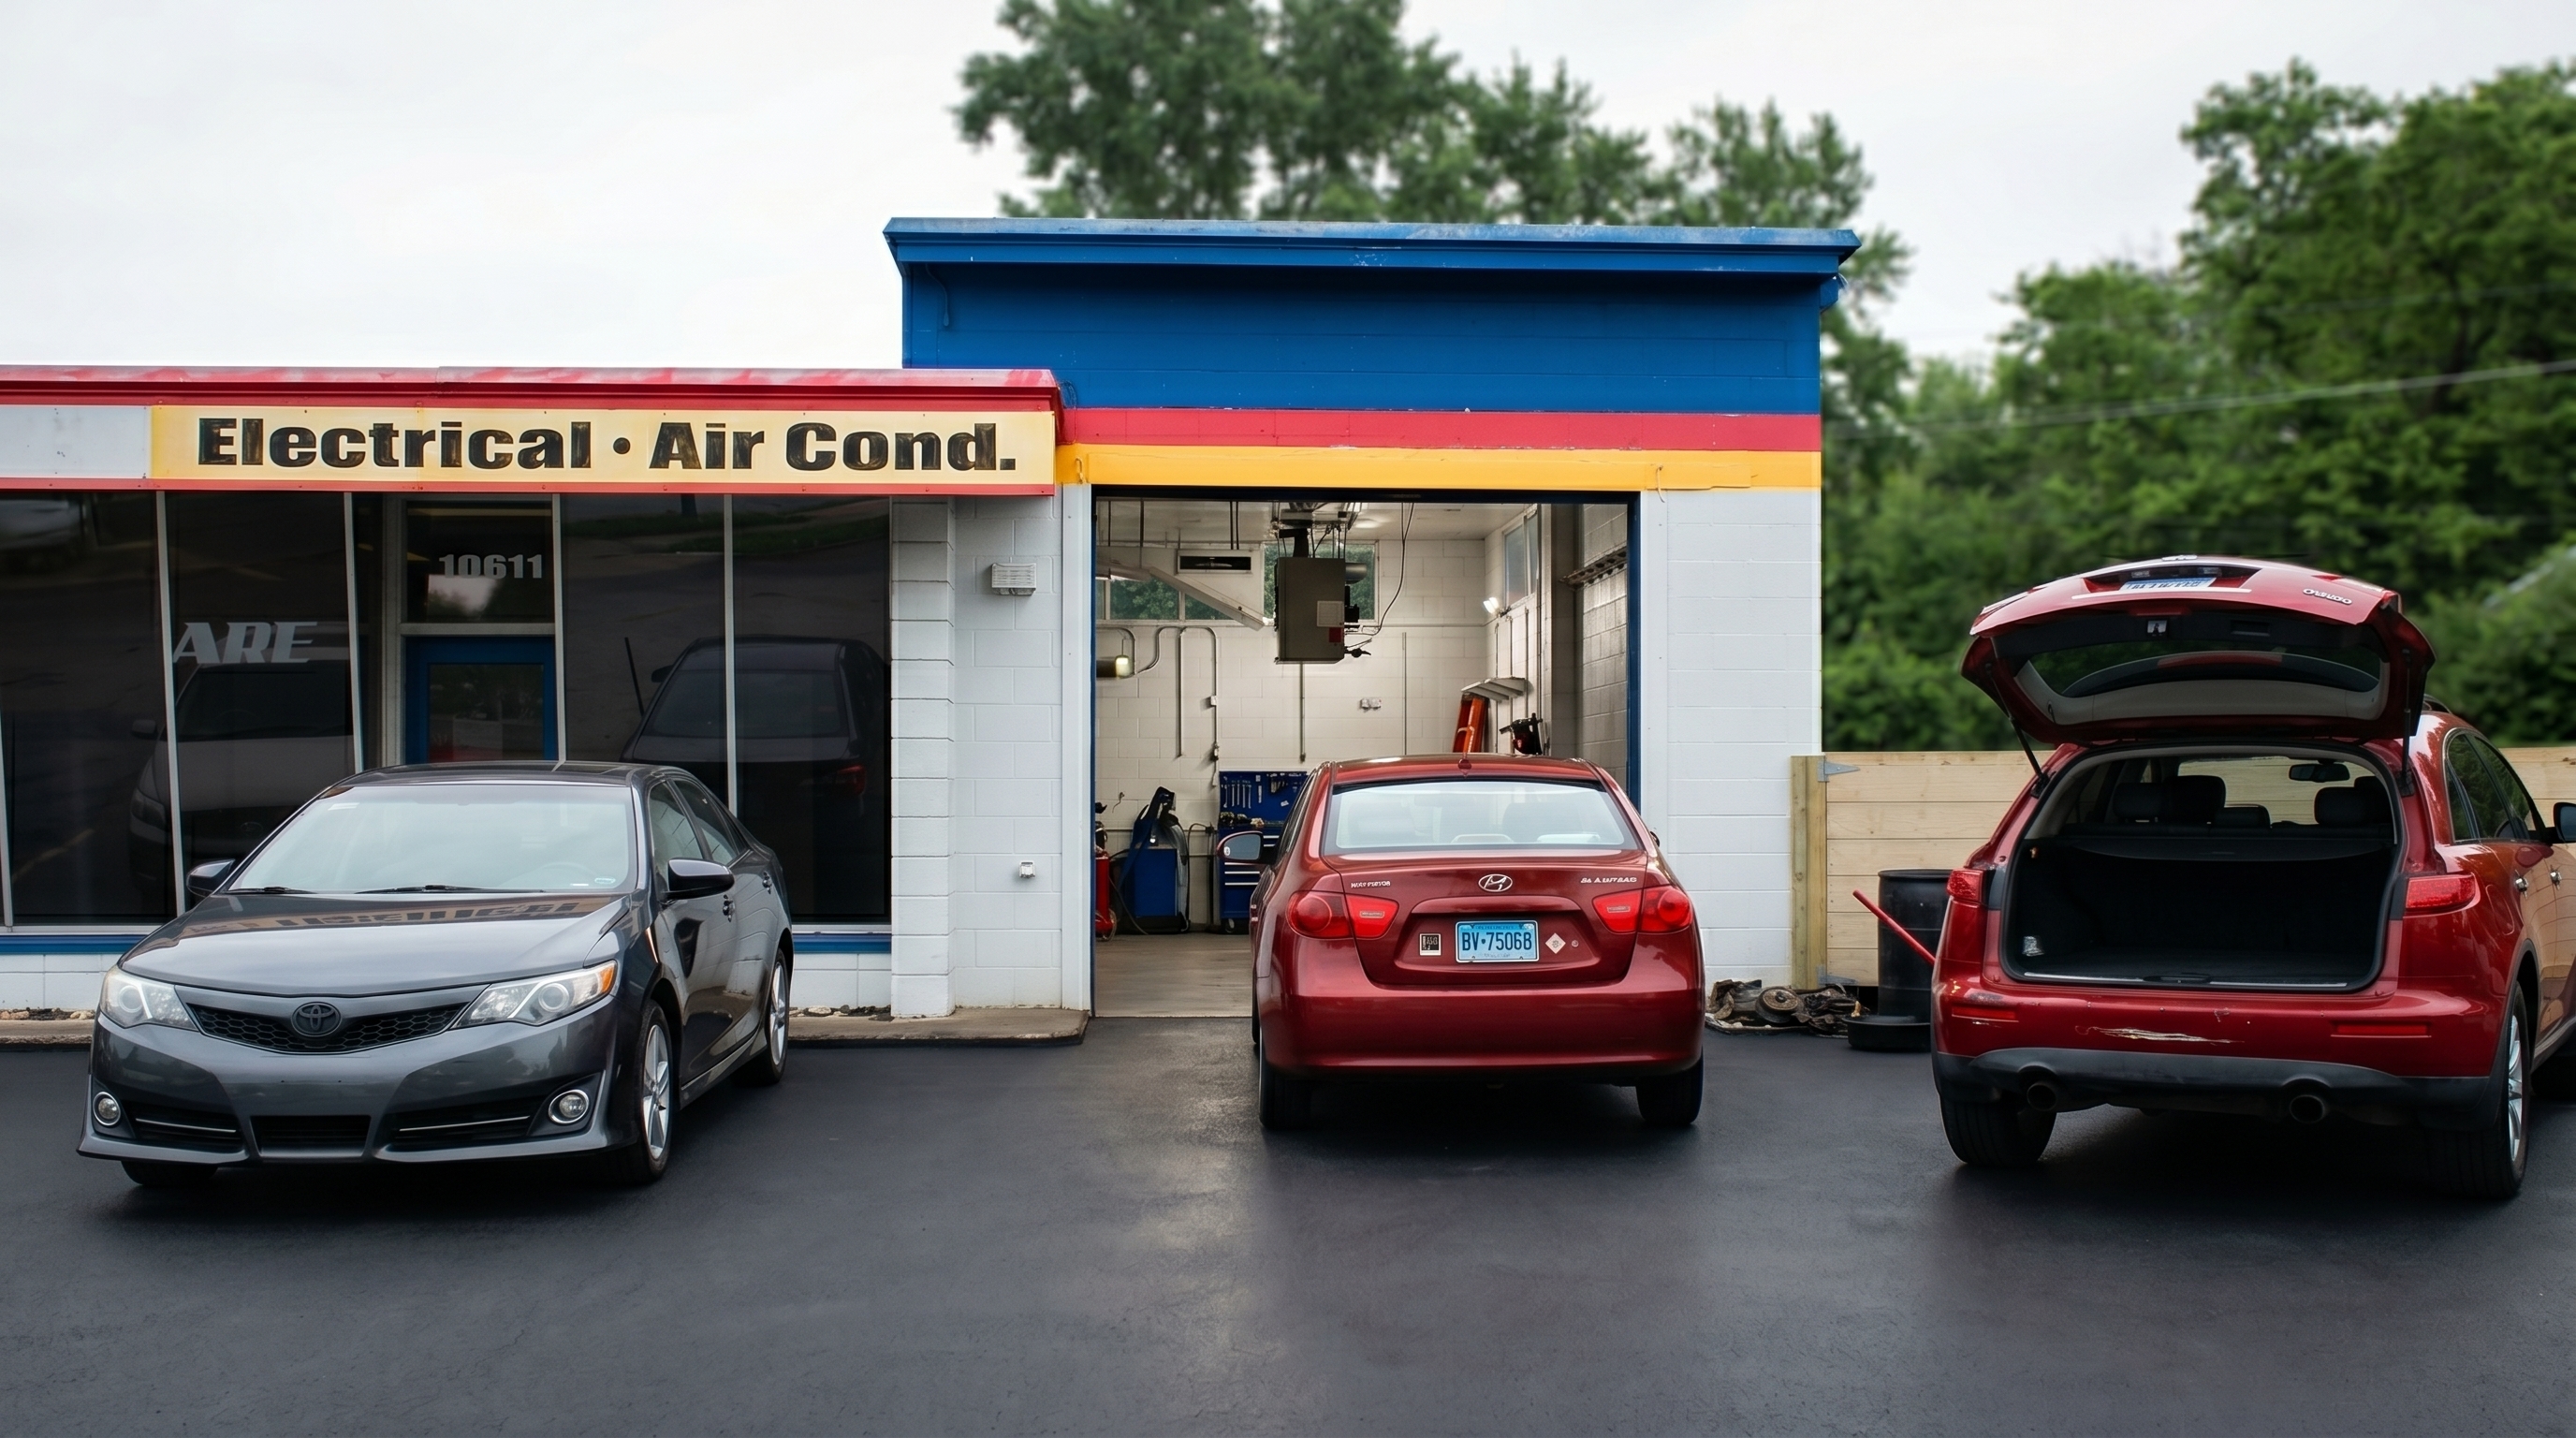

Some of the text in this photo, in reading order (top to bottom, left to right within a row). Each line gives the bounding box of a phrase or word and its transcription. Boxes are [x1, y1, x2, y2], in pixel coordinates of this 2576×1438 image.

[198, 418, 592, 470] Electrical
[649, 421, 765, 470] Air
[785, 421, 1017, 471] Cond.
[438, 553, 543, 580] 10611
[172, 621, 318, 664] ARE
